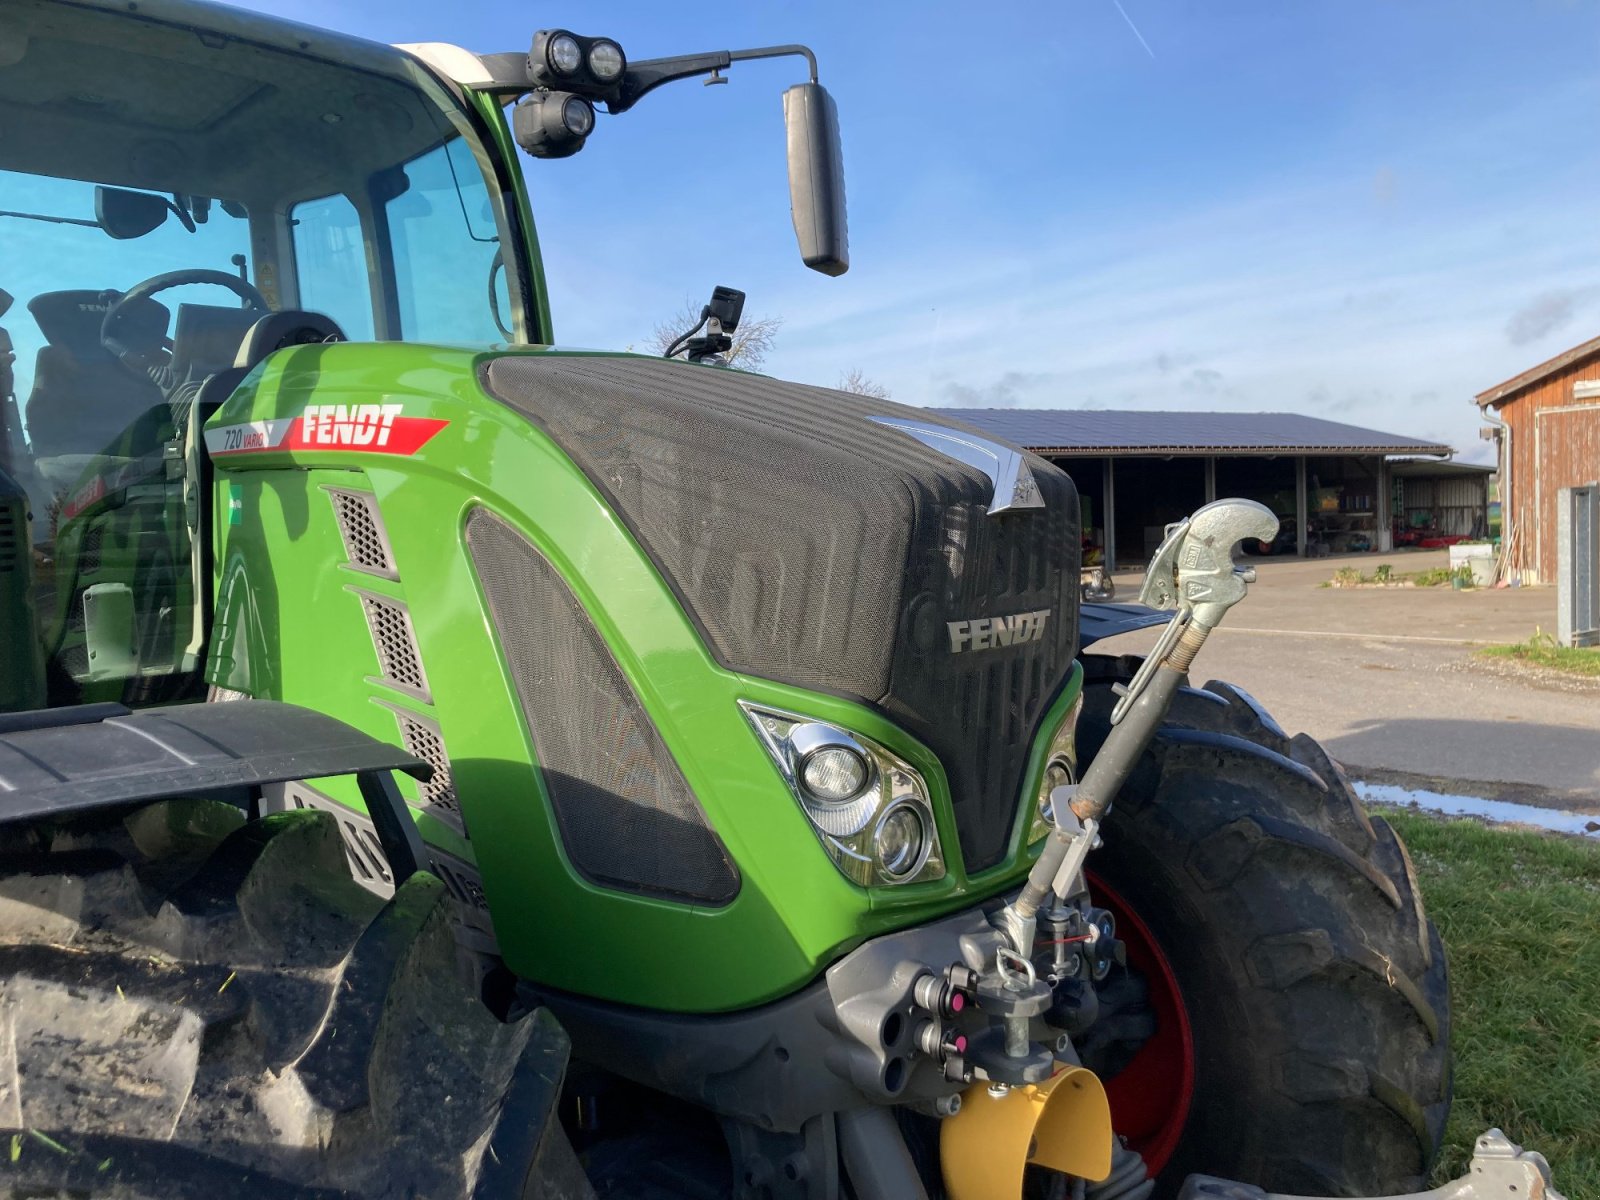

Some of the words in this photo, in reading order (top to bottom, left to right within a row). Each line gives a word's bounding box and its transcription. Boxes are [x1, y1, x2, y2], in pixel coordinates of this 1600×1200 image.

[224, 428, 242, 450] 720
[243, 432, 264, 448] VARIO
[302, 404, 403, 446] FENDT
[946, 608, 1051, 653] FENDT
